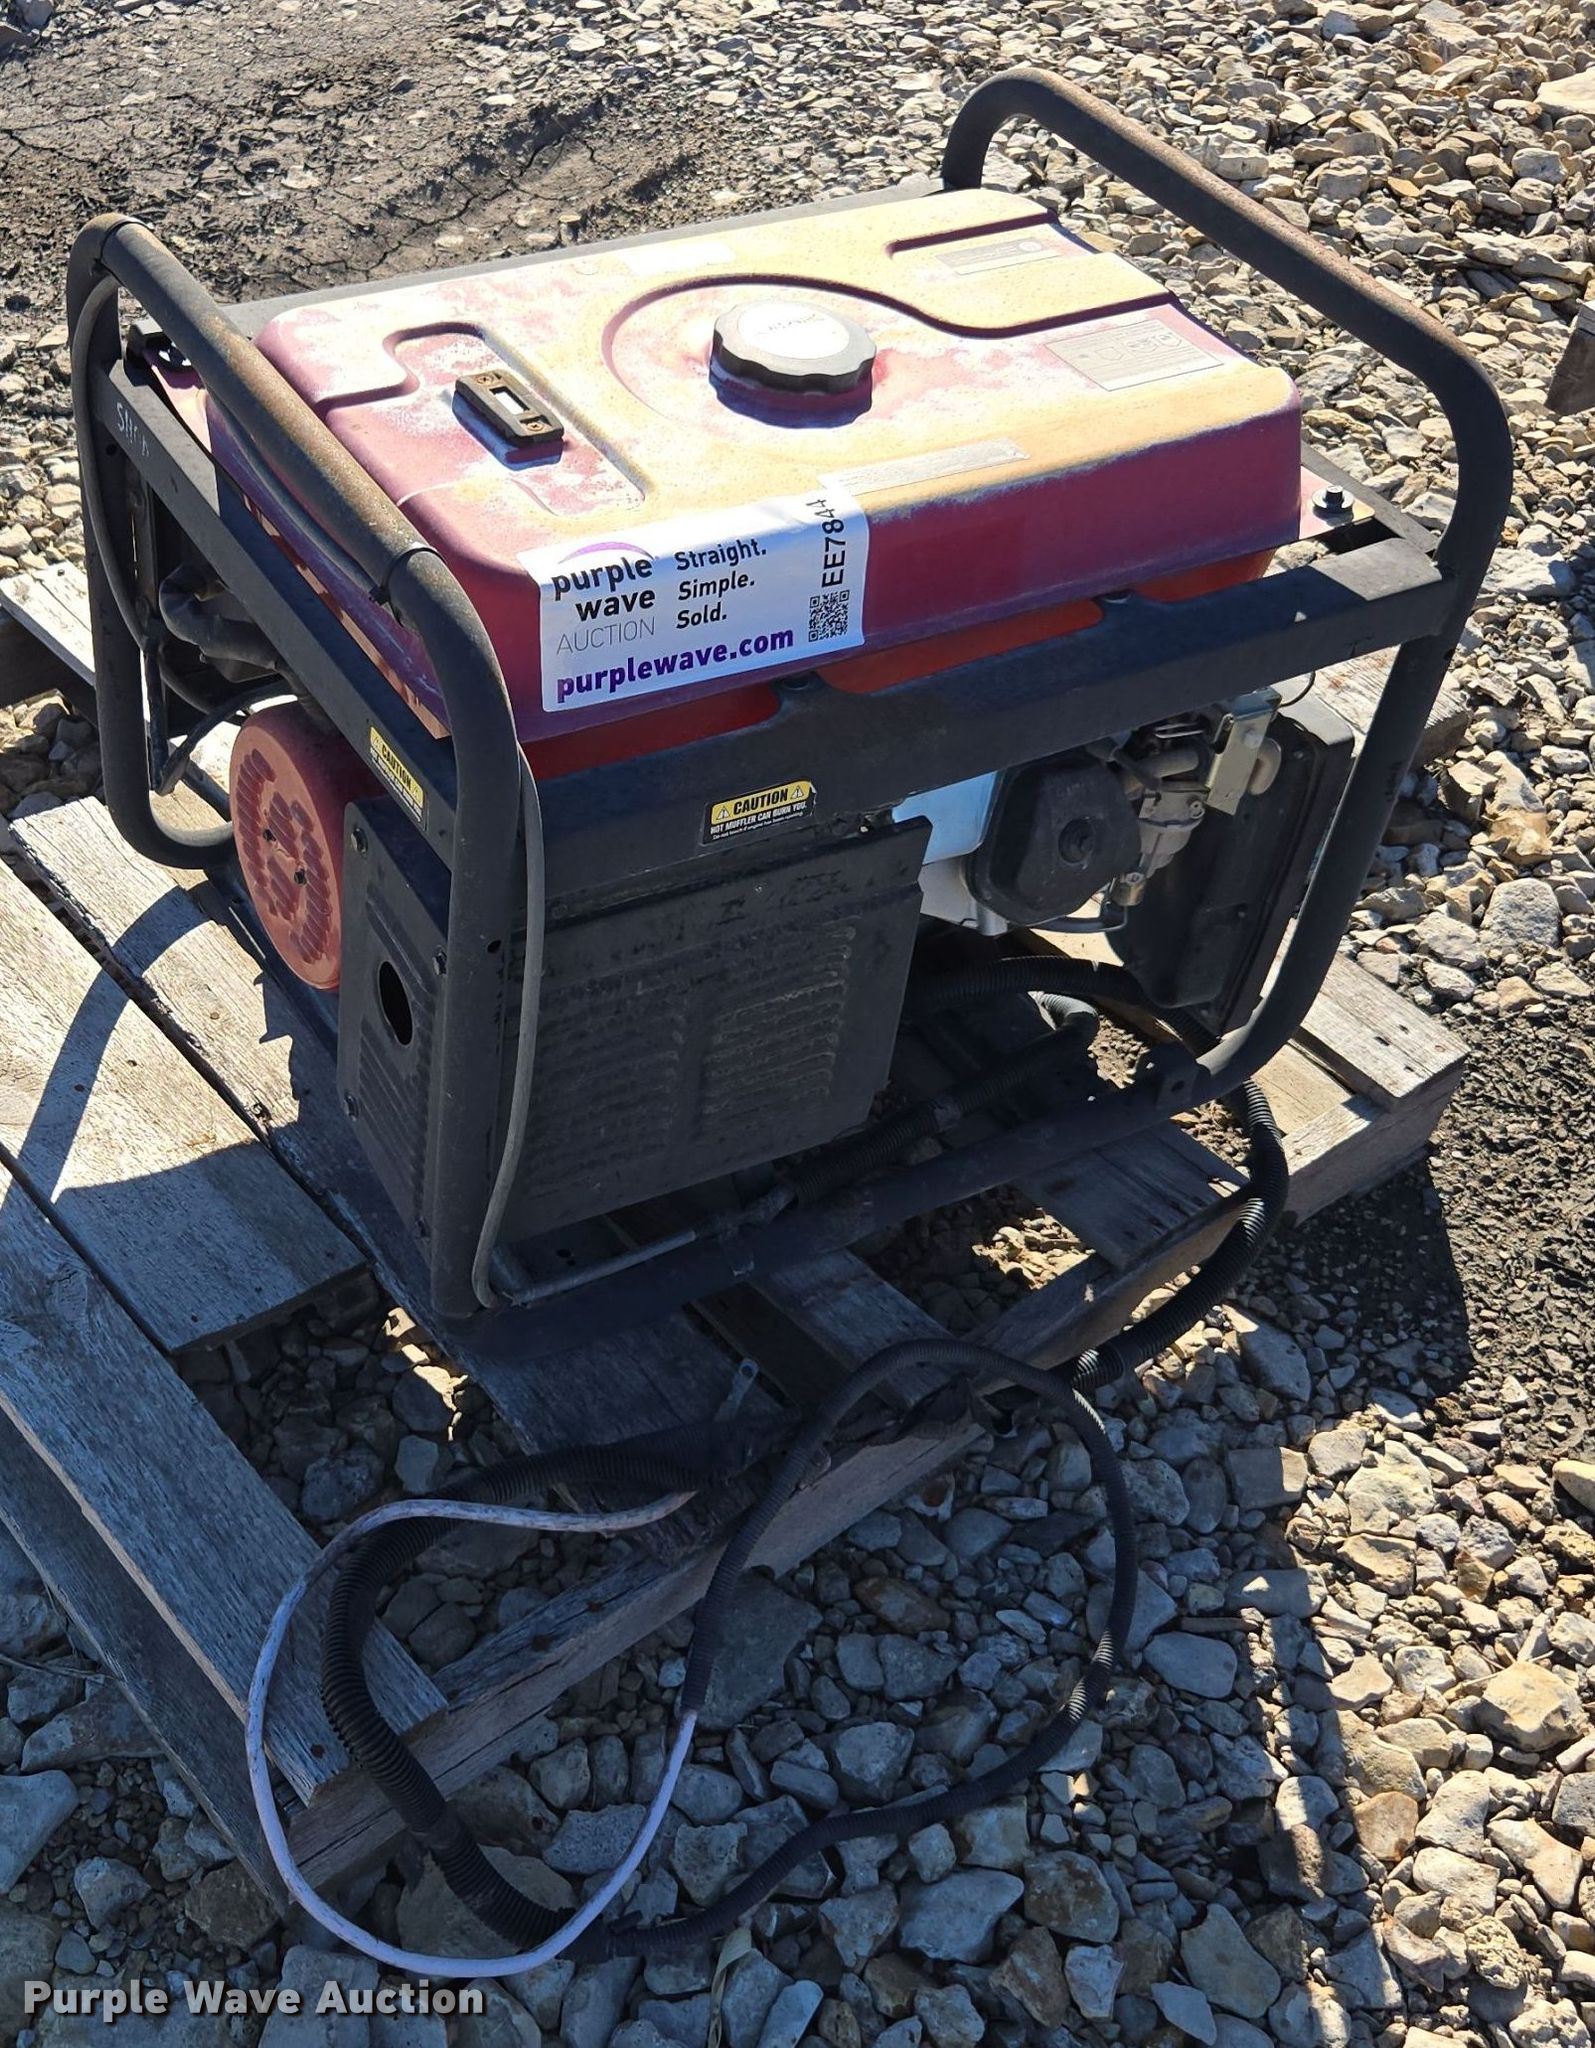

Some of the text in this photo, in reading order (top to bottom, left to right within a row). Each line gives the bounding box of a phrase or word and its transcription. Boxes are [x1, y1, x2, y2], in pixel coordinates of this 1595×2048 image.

[675, 538, 767, 571] Straight.
[806, 498, 846, 588] EE7844
[551, 556, 653, 601] purple
[678, 571, 755, 601] Simple.
[575, 588, 656, 622] wave
[676, 602, 727, 629] Sold.
[556, 616, 656, 655] AUCTION
[557, 627, 794, 703] purplewave.com
[381, 744, 412, 790] CAUTION
[733, 788, 788, 815] CAUTION
